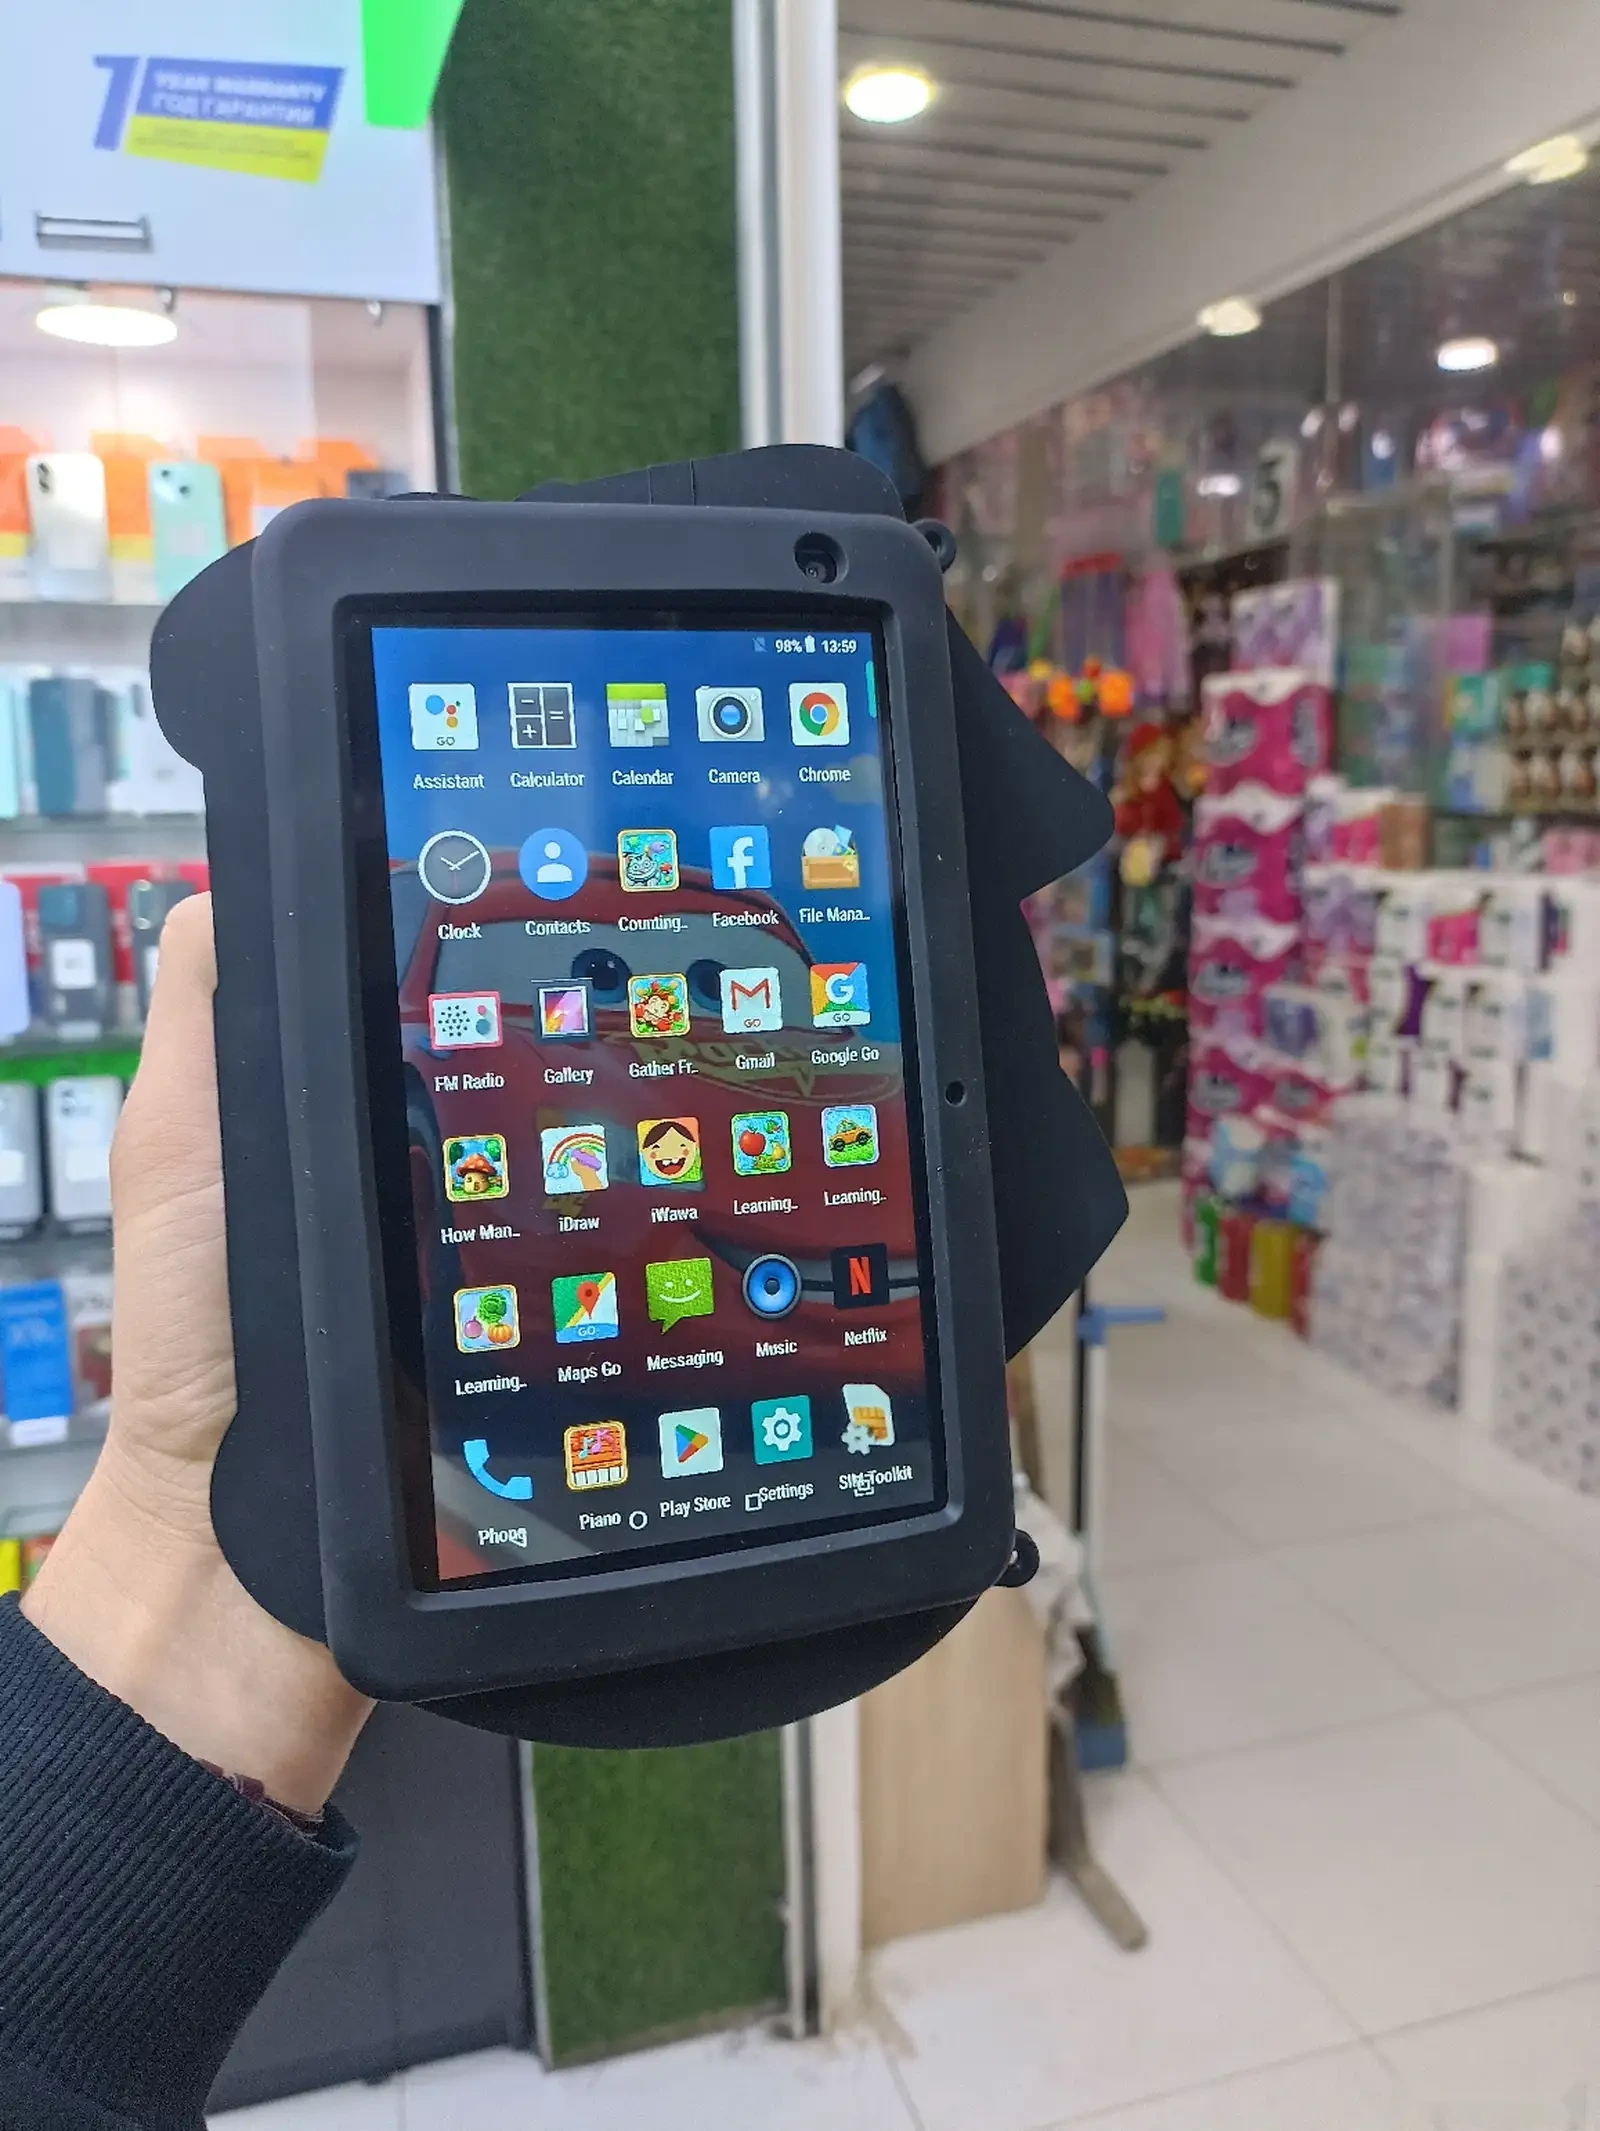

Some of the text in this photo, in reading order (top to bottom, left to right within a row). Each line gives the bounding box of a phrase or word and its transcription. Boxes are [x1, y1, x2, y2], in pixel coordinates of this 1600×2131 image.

[775, 638, 857, 654] 98% 13:59
[436, 736, 456, 746] GO
[413, 772, 485, 789] Assistant
[510, 770, 585, 788] Calculator
[612, 768, 674, 785] Calendar
[708, 768, 761, 784] Camera
[799, 766, 851, 782] Chrome
[713, 909, 779, 928] Facebook
[799, 907, 824, 923] File
[438, 922, 482, 940] Clock
[525, 919, 591, 936] Contacts
[736, 1052, 775, 1071] Gmail
[811, 1046, 879, 1066] Google Go
[544, 1067, 593, 1085] Gallery
[629, 1060, 675, 1078] Gather
[434, 1073, 505, 1092] FM Radio
[651, 1206, 698, 1223] iWawa
[558, 1216, 600, 1232] iDraw
[441, 1227, 476, 1244] How
[844, 1327, 888, 1347] Netflix
[756, 1338, 798, 1358] Music
[647, 1349, 724, 1371] Messaging
[558, 1361, 622, 1384] Maps Go
[759, 1481, 814, 1502] Settings
[660, 1494, 731, 1518] Play Store
[579, 1511, 621, 1530] Piano
